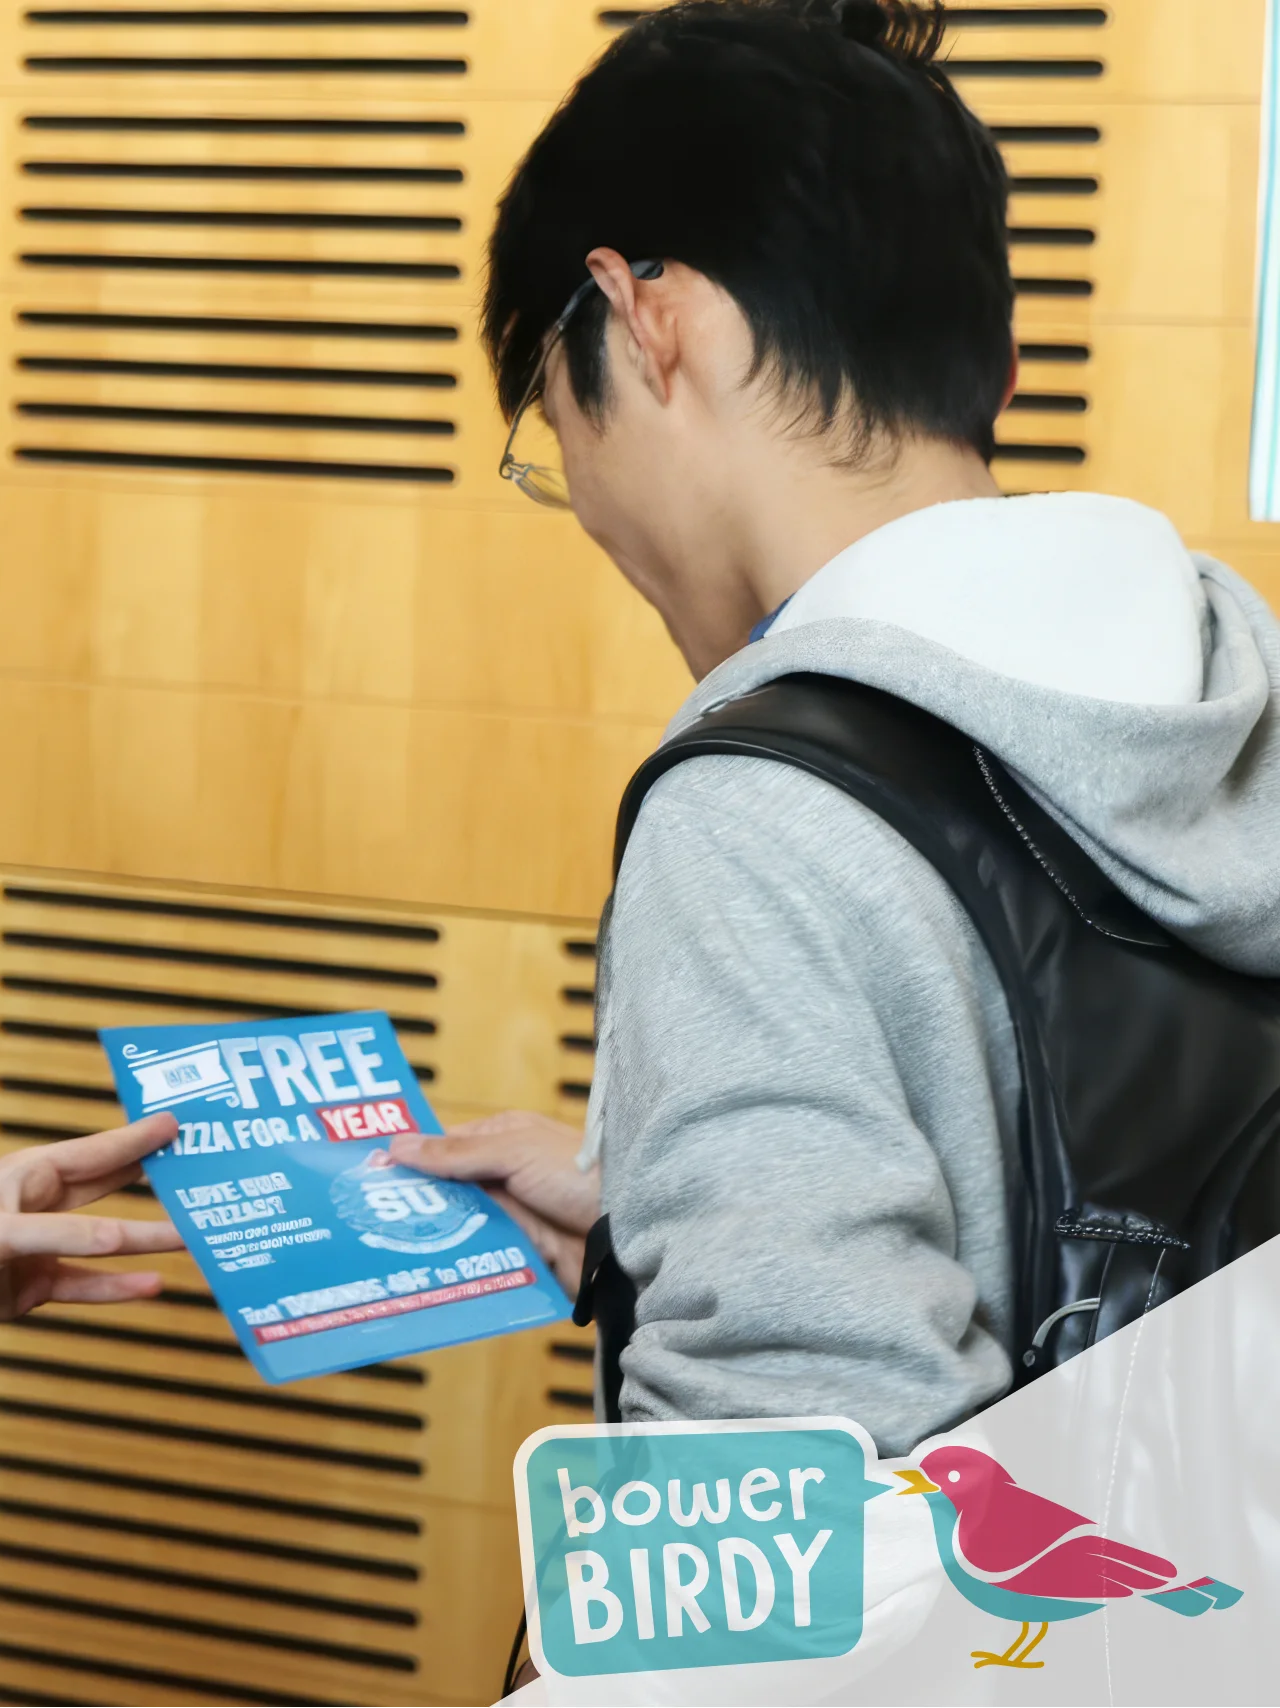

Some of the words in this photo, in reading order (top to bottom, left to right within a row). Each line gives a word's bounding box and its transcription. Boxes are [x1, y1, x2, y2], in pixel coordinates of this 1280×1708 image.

[219, 1027, 402, 1109] FREE
[156, 1121, 236, 1157] IZZA
[232, 1117, 296, 1150] FOR
[296, 1113, 322, 1143] A
[321, 1101, 410, 1140] YEAR
[364, 1185, 448, 1222] SU
